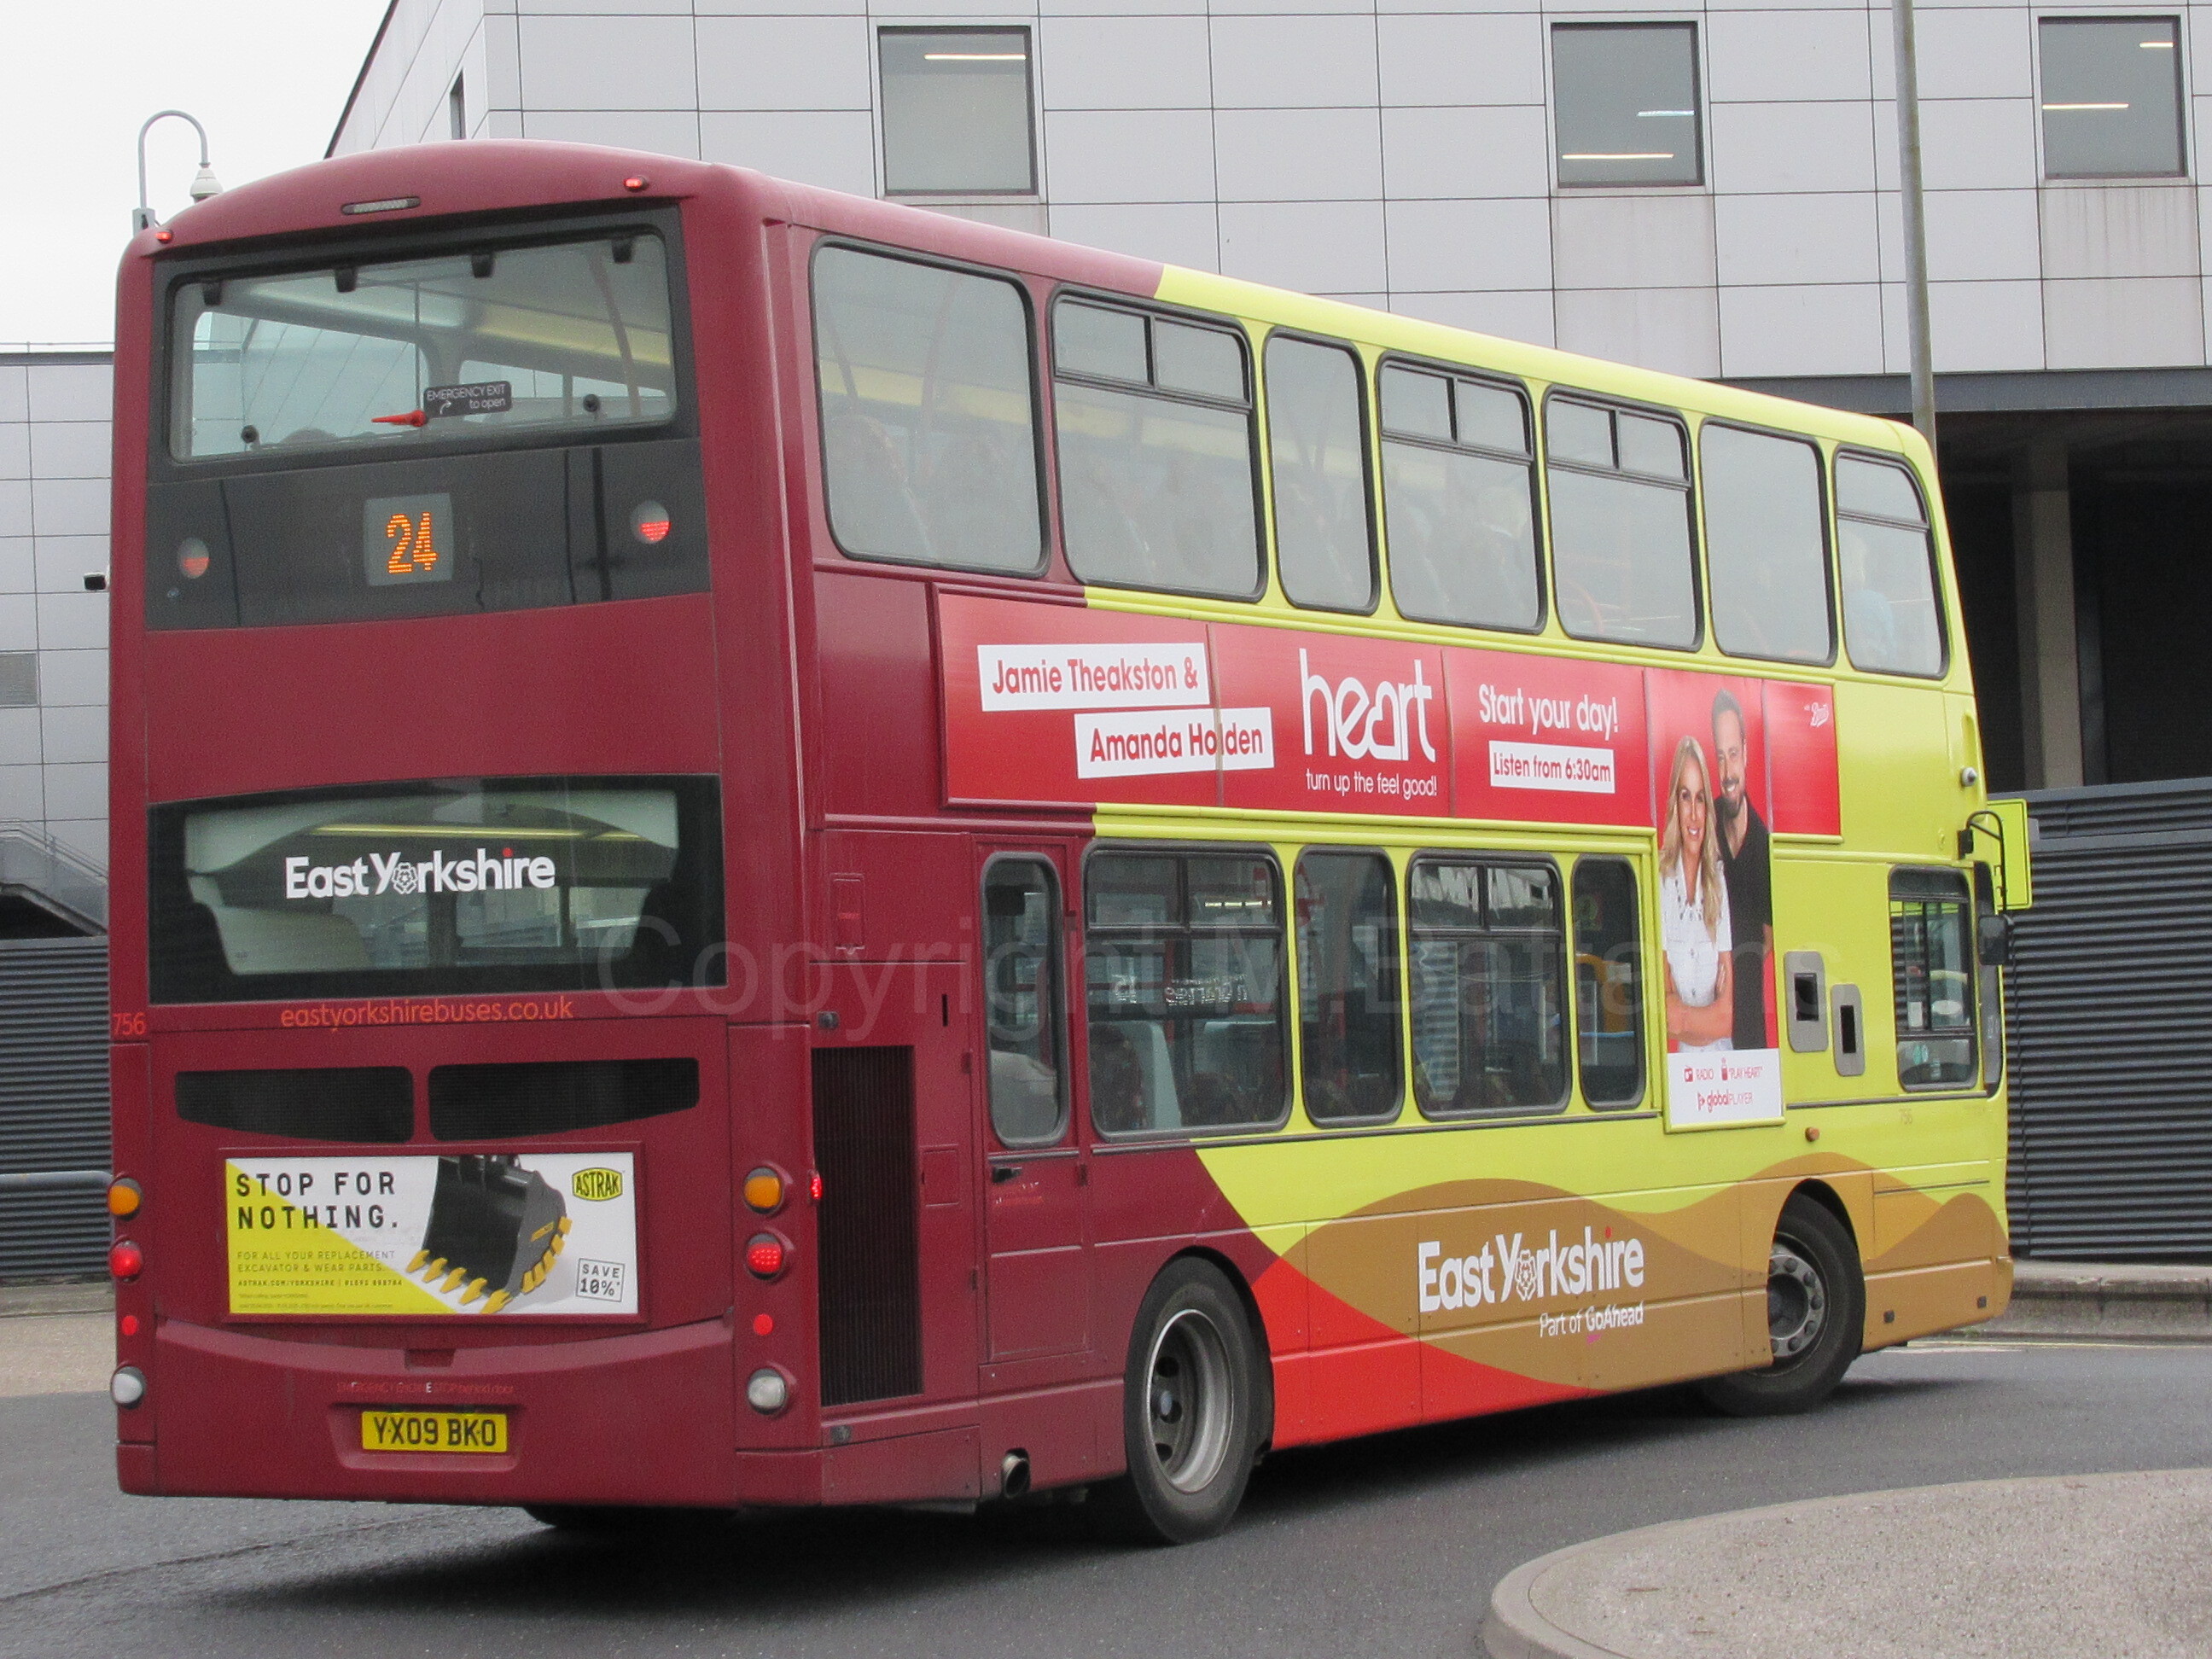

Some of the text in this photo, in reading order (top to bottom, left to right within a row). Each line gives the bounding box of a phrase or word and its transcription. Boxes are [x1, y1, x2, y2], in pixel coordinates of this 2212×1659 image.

[427, 383, 506, 401] EMERGENCY EXIT
[469, 398, 506, 410] to open
[386, 511, 439, 574] 24
[992, 656, 1198, 694] Jamie Theakston &
[1299, 648, 1436, 763] heart
[1478, 684, 1618, 741] Start your day!
[1091, 725, 1183, 762] Amanda
[1493, 752, 1612, 782] Listen from 6:30am
[1306, 768, 1438, 800] turn up the feel good!
[285, 856, 370, 899] East
[113, 1012, 147, 1035] 756
[280, 996, 574, 1032] eastyorkshirebuses.co.uk
[1696, 1068, 1714, 1080] RADIO
[236, 1172, 395, 1196] STOP FOR
[576, 1172, 619, 1198] ASTRAK
[238, 1204, 398, 1229] NOTHING.
[237, 1250, 395, 1260] FOR ALL YOUR REPLACEMENT
[238, 1263, 299, 1272] EXCAVATOR
[304, 1263, 309, 1272] &
[315, 1263, 344, 1272] WEAR
[582, 1264, 620, 1278] SAVE
[1418, 1241, 1496, 1313] East
[1540, 1301, 1644, 1337] Part of GoAhead
[374, 1417, 496, 1446] YX09 BKO
